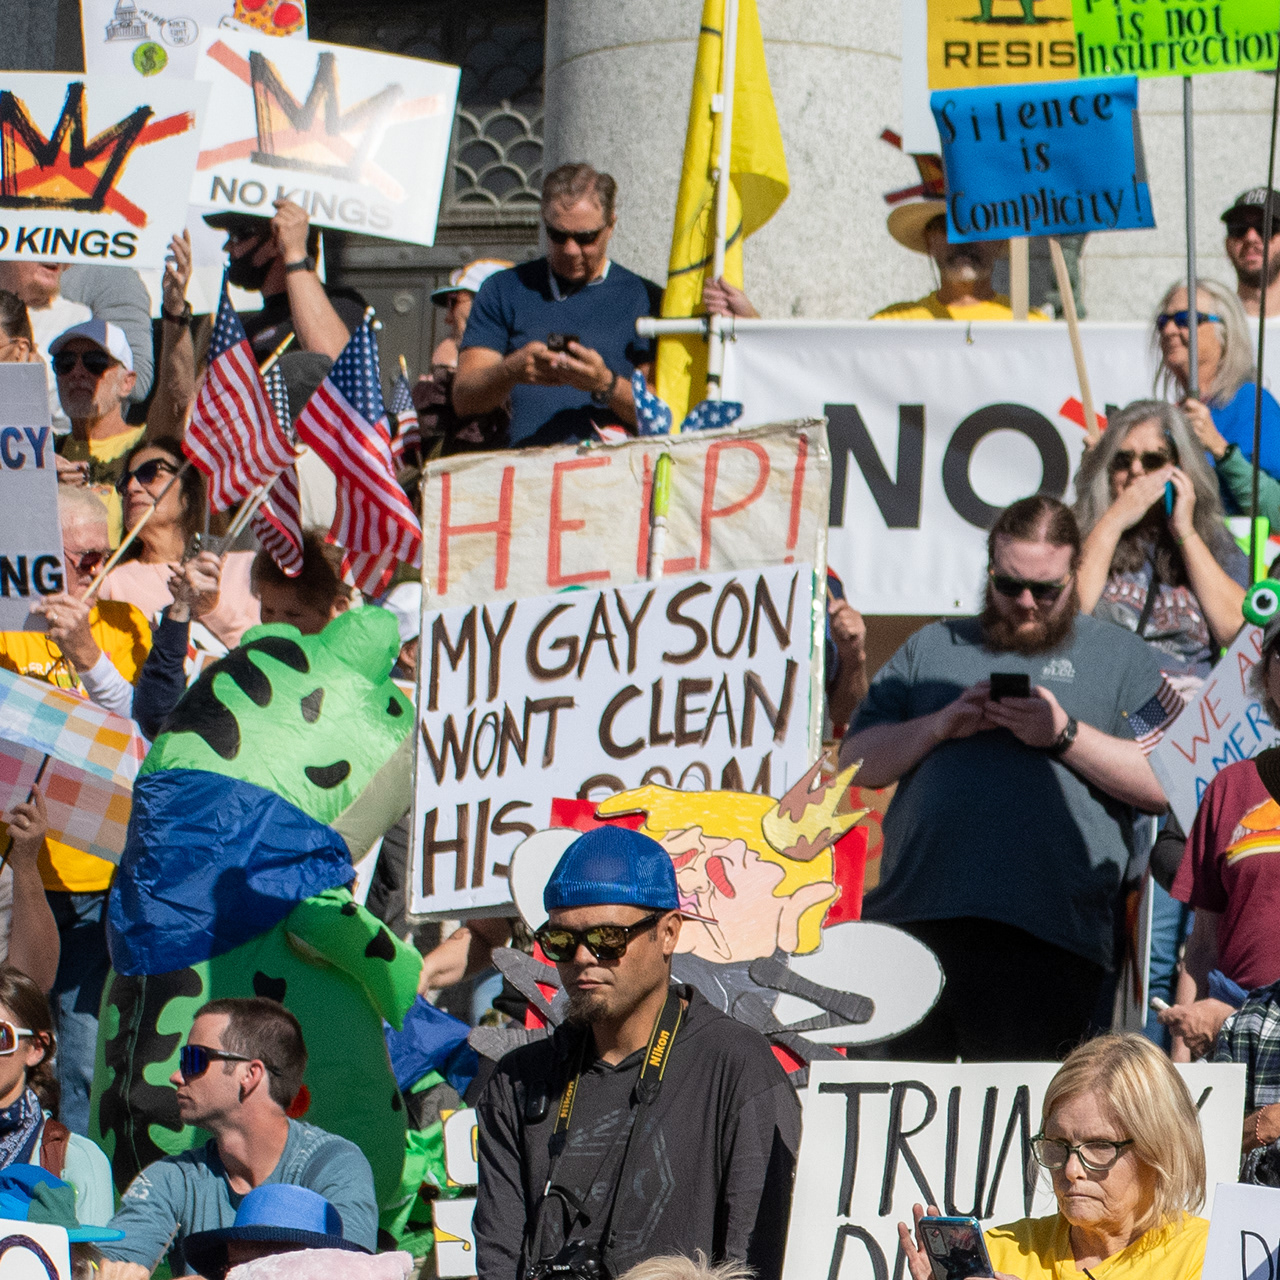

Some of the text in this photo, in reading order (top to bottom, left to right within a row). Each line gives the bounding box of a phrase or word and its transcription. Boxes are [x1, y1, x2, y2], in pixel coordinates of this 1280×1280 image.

[1117, 4, 1225, 41] is not
[943, 40, 1076, 69] RESIS
[941, 91, 1114, 145] Silence
[1020, 138, 1051, 173] is
[210, 174, 394, 233] NO KINGS
[15, 226, 138, 260] KINGS
[0, 426, 51, 470] CY
[815, 403, 1071, 530] NO
[438, 433, 810, 597] HELP!
[427, 570, 799, 713] MY GAY SON
[421, 695, 576, 787] WONT
[599, 658, 799, 760] CLEAN
[1170, 679, 1232, 766] WE
[421, 797, 537, 899] HIS
[649, 1029, 670, 1068] Nikon
[560, 1080, 575, 1118] Nikon
